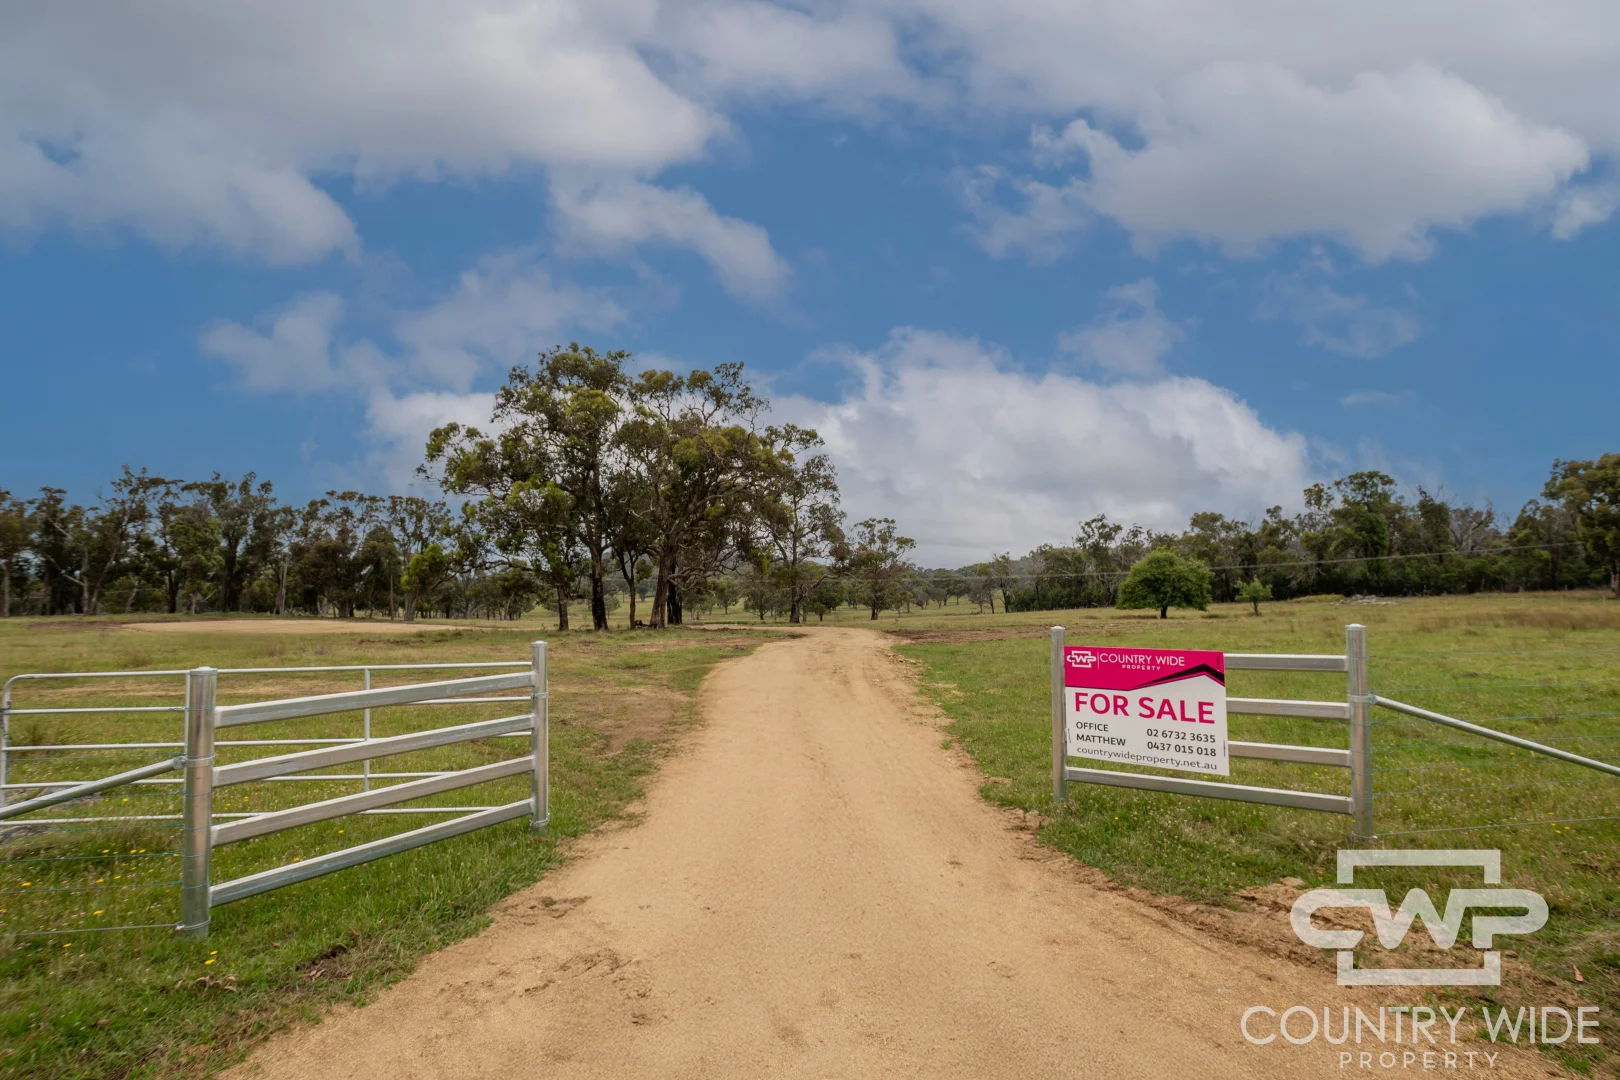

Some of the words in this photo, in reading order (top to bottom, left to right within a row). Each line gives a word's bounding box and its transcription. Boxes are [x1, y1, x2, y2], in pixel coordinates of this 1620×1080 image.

[1100, 653, 1152, 664] COUNTRY
[1155, 656, 1185, 666] WIDE
[1075, 692, 1130, 717] FOR
[1139, 697, 1215, 724] SALE
[1076, 721, 1108, 732] OFFICE
[1147, 729, 1158, 737] 02
[1161, 730, 1187, 740] 6732
[1190, 733, 1216, 743] 3635
[1076, 734, 1126, 746] MATTHEW
[1147, 742, 1171, 751] 0437
[1175, 744, 1193, 754] 015
[1197, 747, 1216, 756] 018
[1077, 747, 1217, 770] countrywideproperty.net.au
